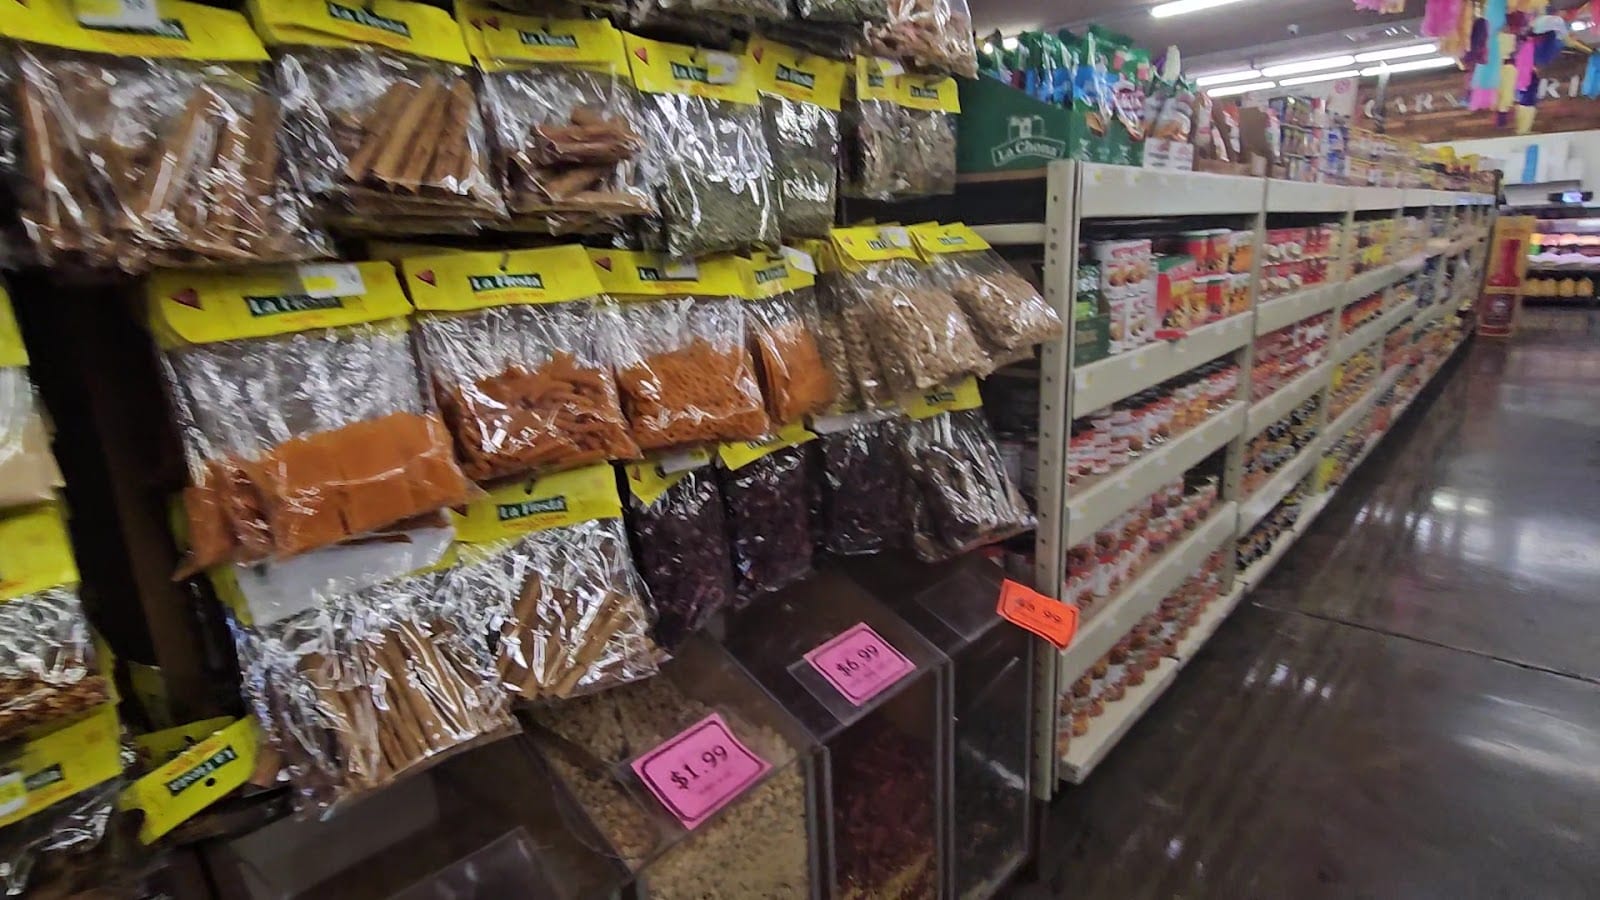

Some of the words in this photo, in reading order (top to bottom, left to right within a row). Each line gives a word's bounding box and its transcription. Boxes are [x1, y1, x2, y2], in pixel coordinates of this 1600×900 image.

[500, 506, 520, 519] La
[836, 645, 879, 677] $6.99
[671, 745, 727, 790] $1.99
